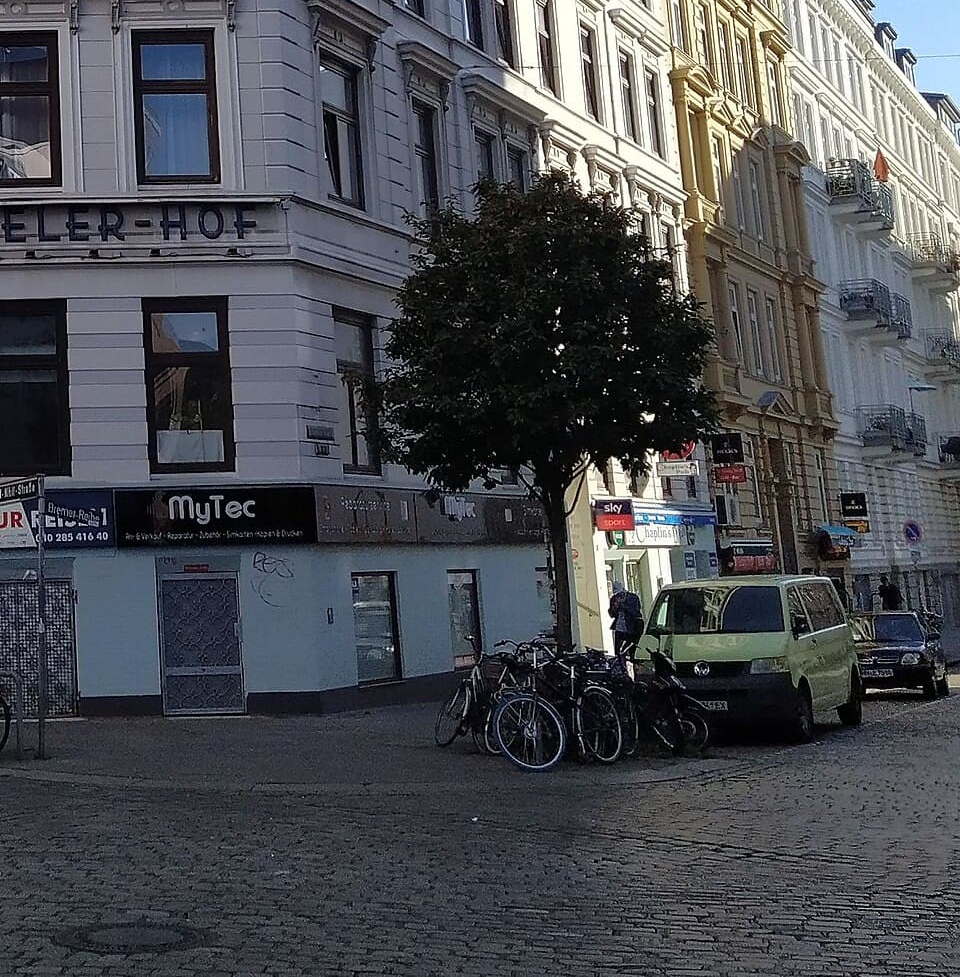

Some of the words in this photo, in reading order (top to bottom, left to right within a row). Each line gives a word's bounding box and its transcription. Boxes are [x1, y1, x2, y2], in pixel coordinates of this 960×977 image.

[169, 494, 256, 525] MyTec
[603, 501, 624, 515] sky
[55, 532, 73, 542] 285
[75, 532, 94, 541] 416
[96, 531, 109, 541] 40
[635, 525, 672, 544] Chaplin's
